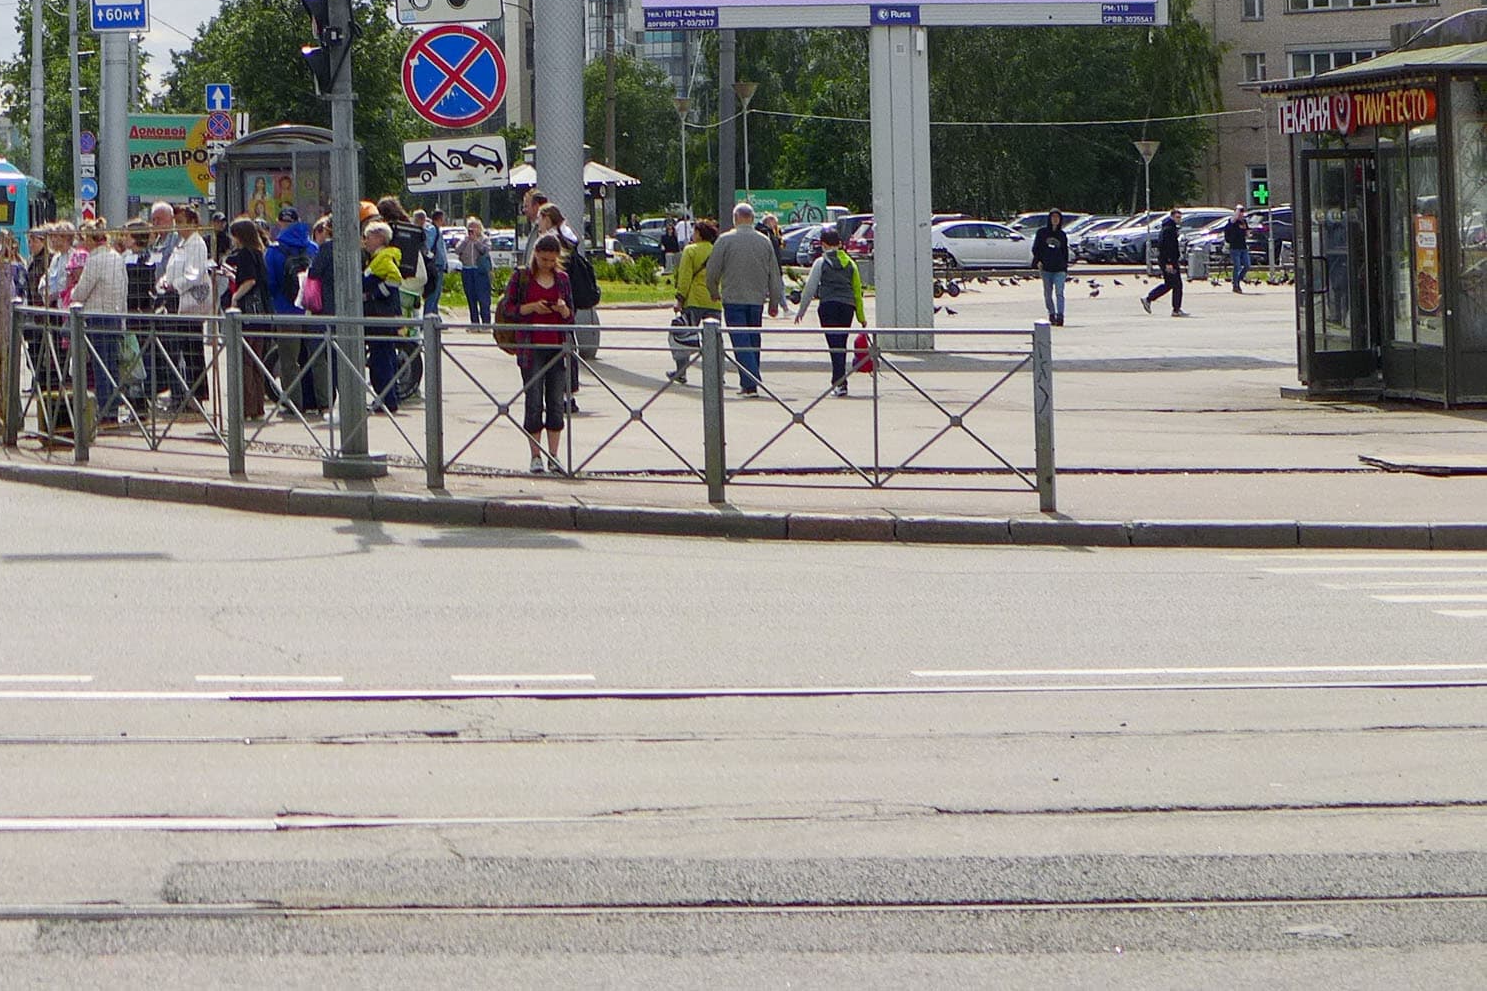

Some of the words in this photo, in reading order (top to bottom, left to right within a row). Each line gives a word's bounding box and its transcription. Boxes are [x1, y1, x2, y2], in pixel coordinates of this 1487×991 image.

[106, 8, 132, 21] 60м
[890, 10, 912, 19] Russ
[1277, 95, 1330, 134] ПЕКАРНЯ
[1354, 89, 1427, 126] ТИЛИ-ТЕСТО
[129, 149, 209, 170] РАСПРО
